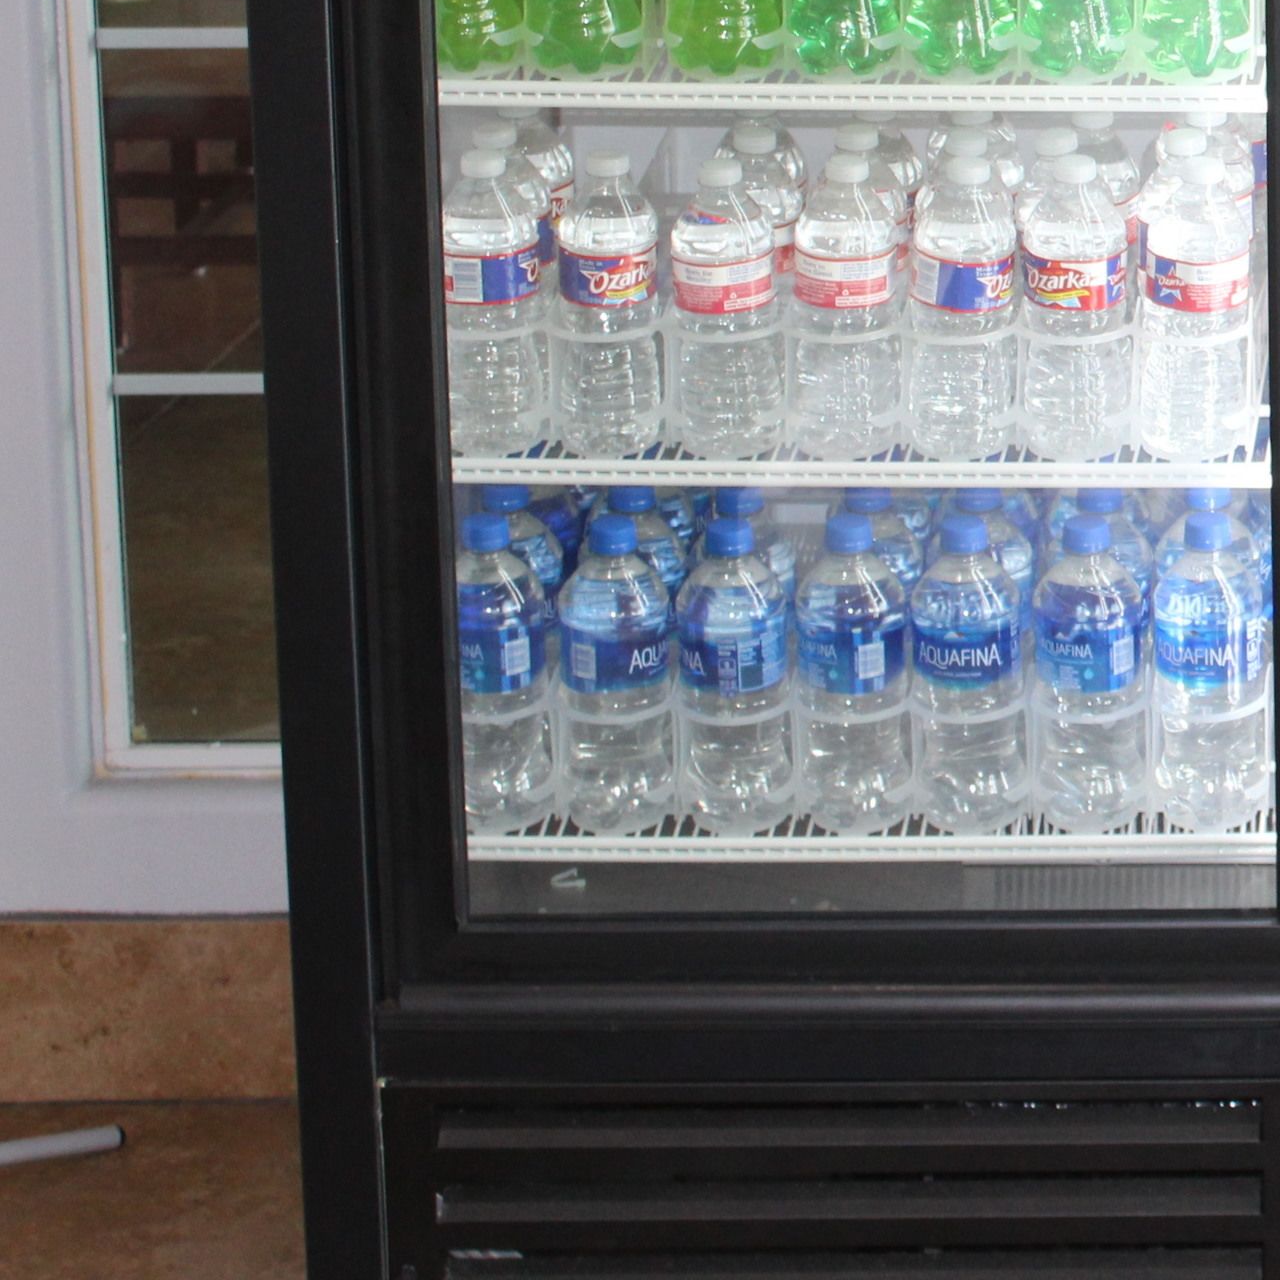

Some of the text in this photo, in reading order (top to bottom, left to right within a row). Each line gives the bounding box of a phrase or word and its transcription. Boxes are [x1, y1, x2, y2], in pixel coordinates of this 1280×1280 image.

[1027, 269, 1093, 290] Ozarka
[629, 643, 667, 674] AQUA
[918, 643, 1002, 671] AQUAFINA
